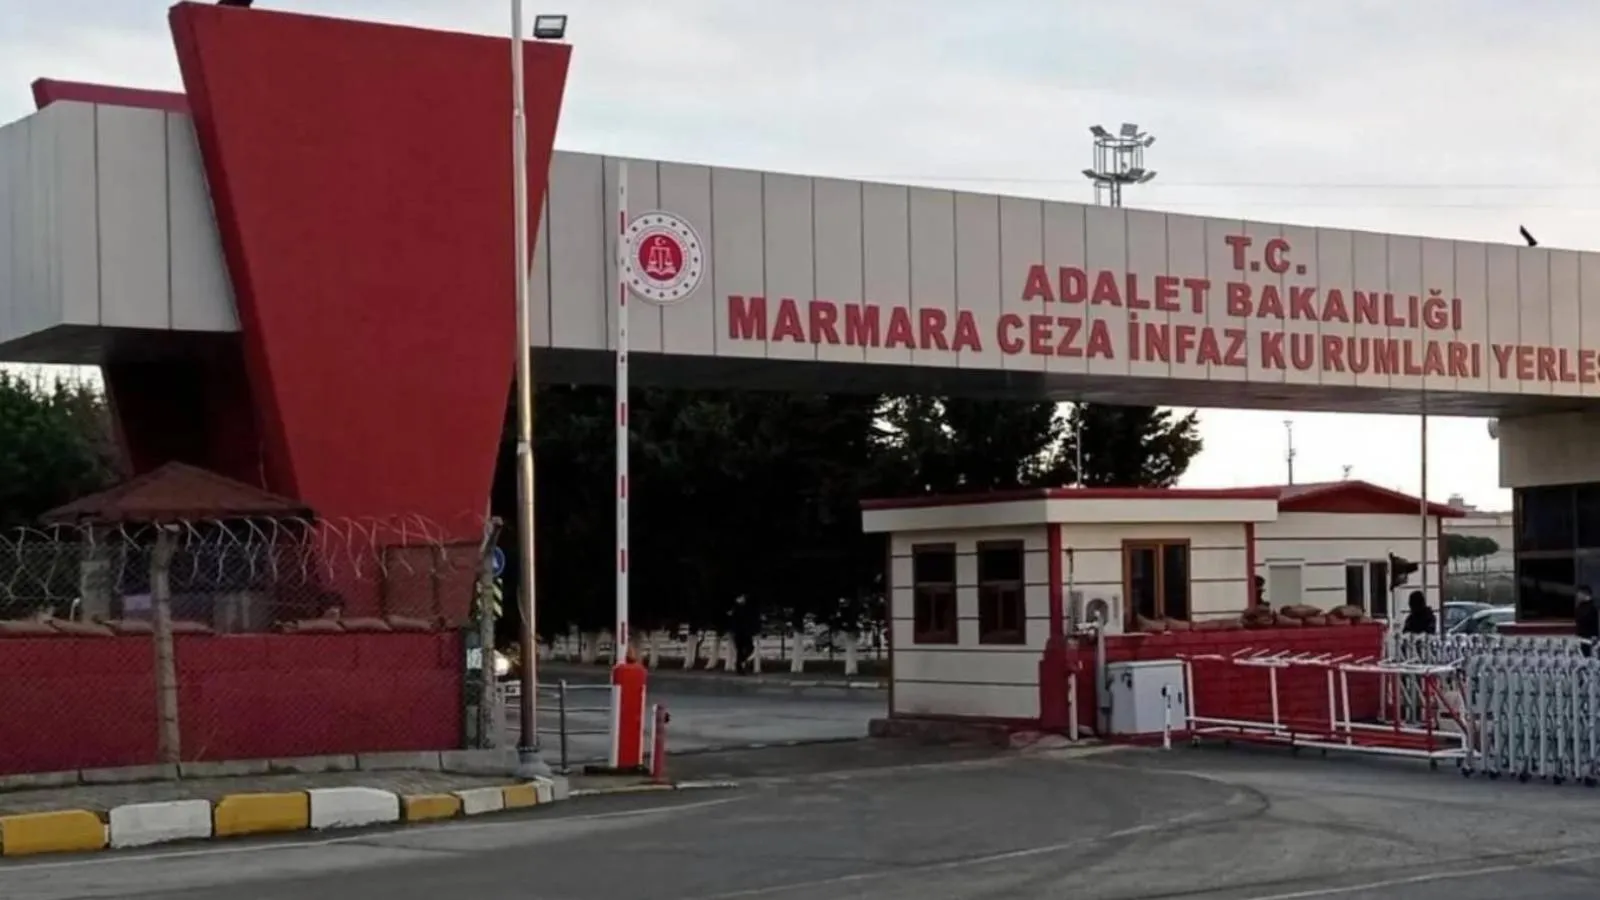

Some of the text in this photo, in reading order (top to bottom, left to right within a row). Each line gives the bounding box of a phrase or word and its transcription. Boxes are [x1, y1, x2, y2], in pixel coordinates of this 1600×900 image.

[1226, 235, 1305, 274] T.C.
[1022, 264, 1462, 331] ADALET BAKANLIĞI
[728, 296, 1600, 384] MARMARA CEZA İNFAZ KURUMLARI YERLE
